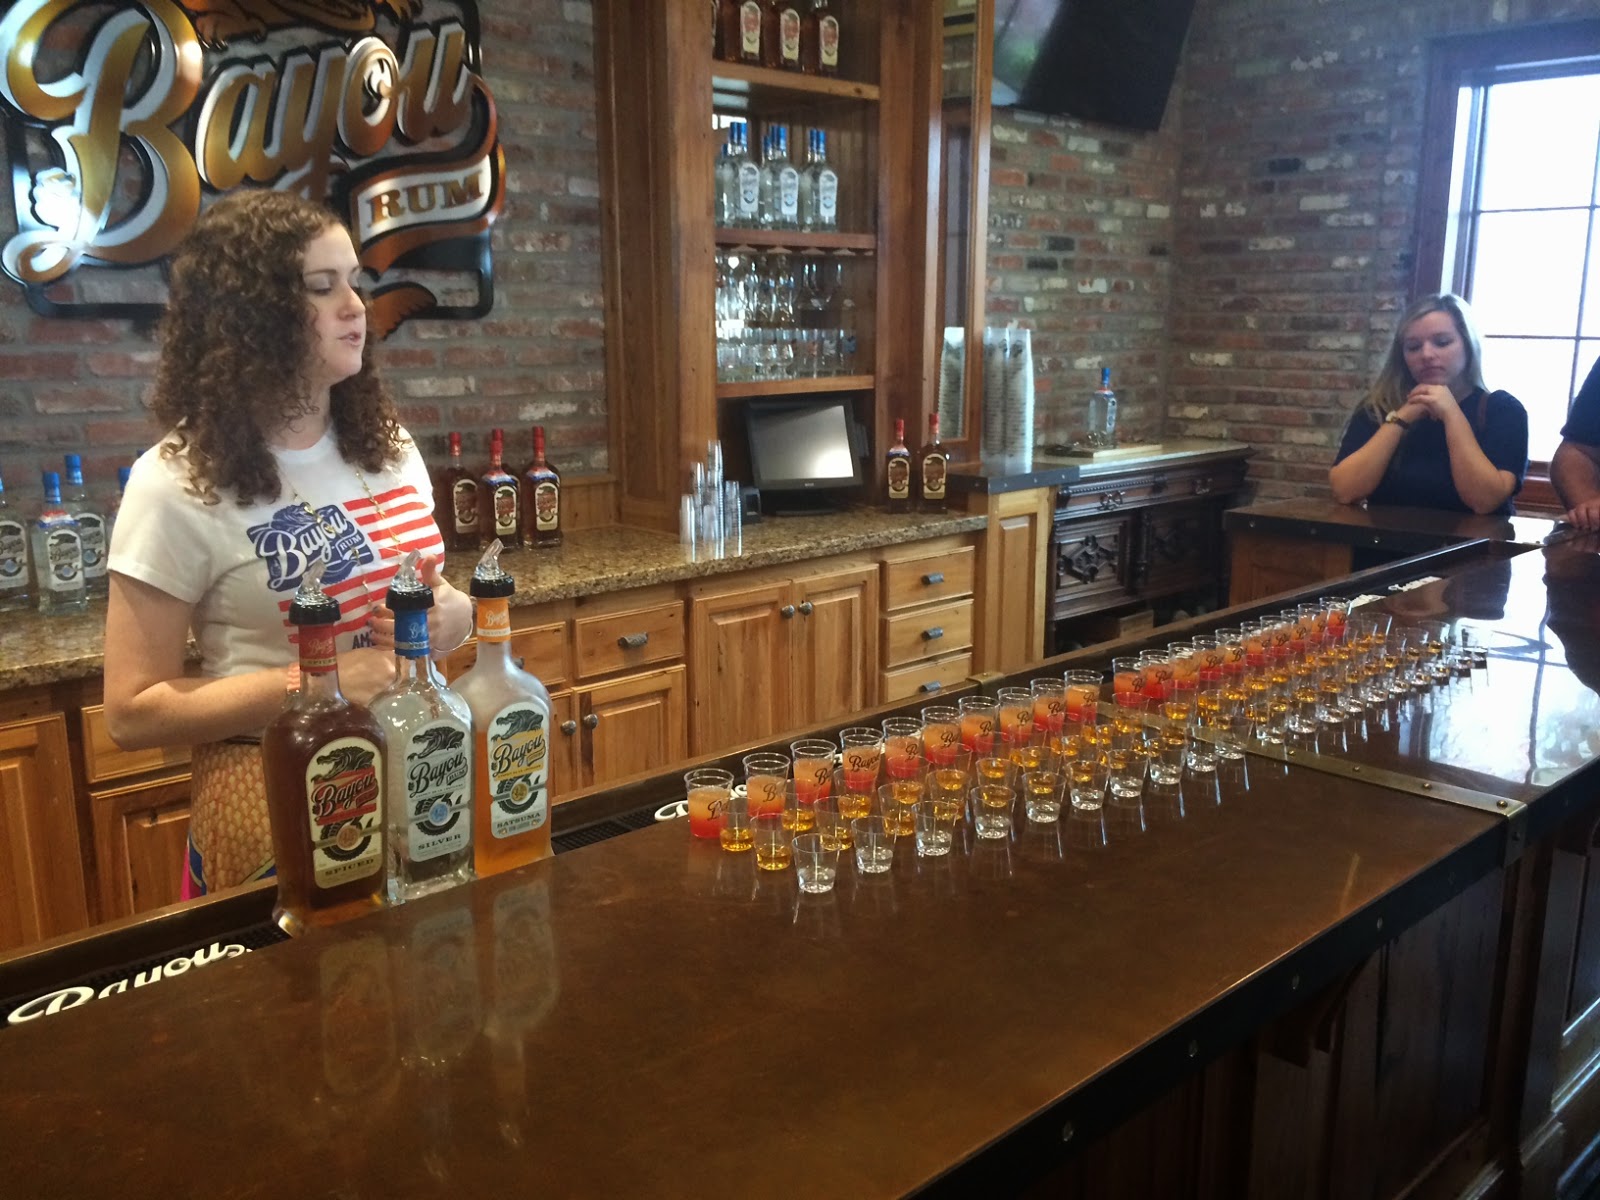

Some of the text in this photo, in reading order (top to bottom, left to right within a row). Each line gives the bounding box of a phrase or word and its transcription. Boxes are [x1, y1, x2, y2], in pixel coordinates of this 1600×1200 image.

[0, 0, 471, 284] Bayou
[365, 168, 484, 228] RUM
[259, 511, 348, 589] Bayou
[339, 534, 363, 551] RUM
[408, 752, 464, 798] Bayou
[490, 734, 542, 778] Bayou
[310, 772, 376, 821] Bayou
[418, 832, 461, 850] SILVER
[496, 812, 541, 829] SATSUMA
[324, 858, 375, 876] SPICED
